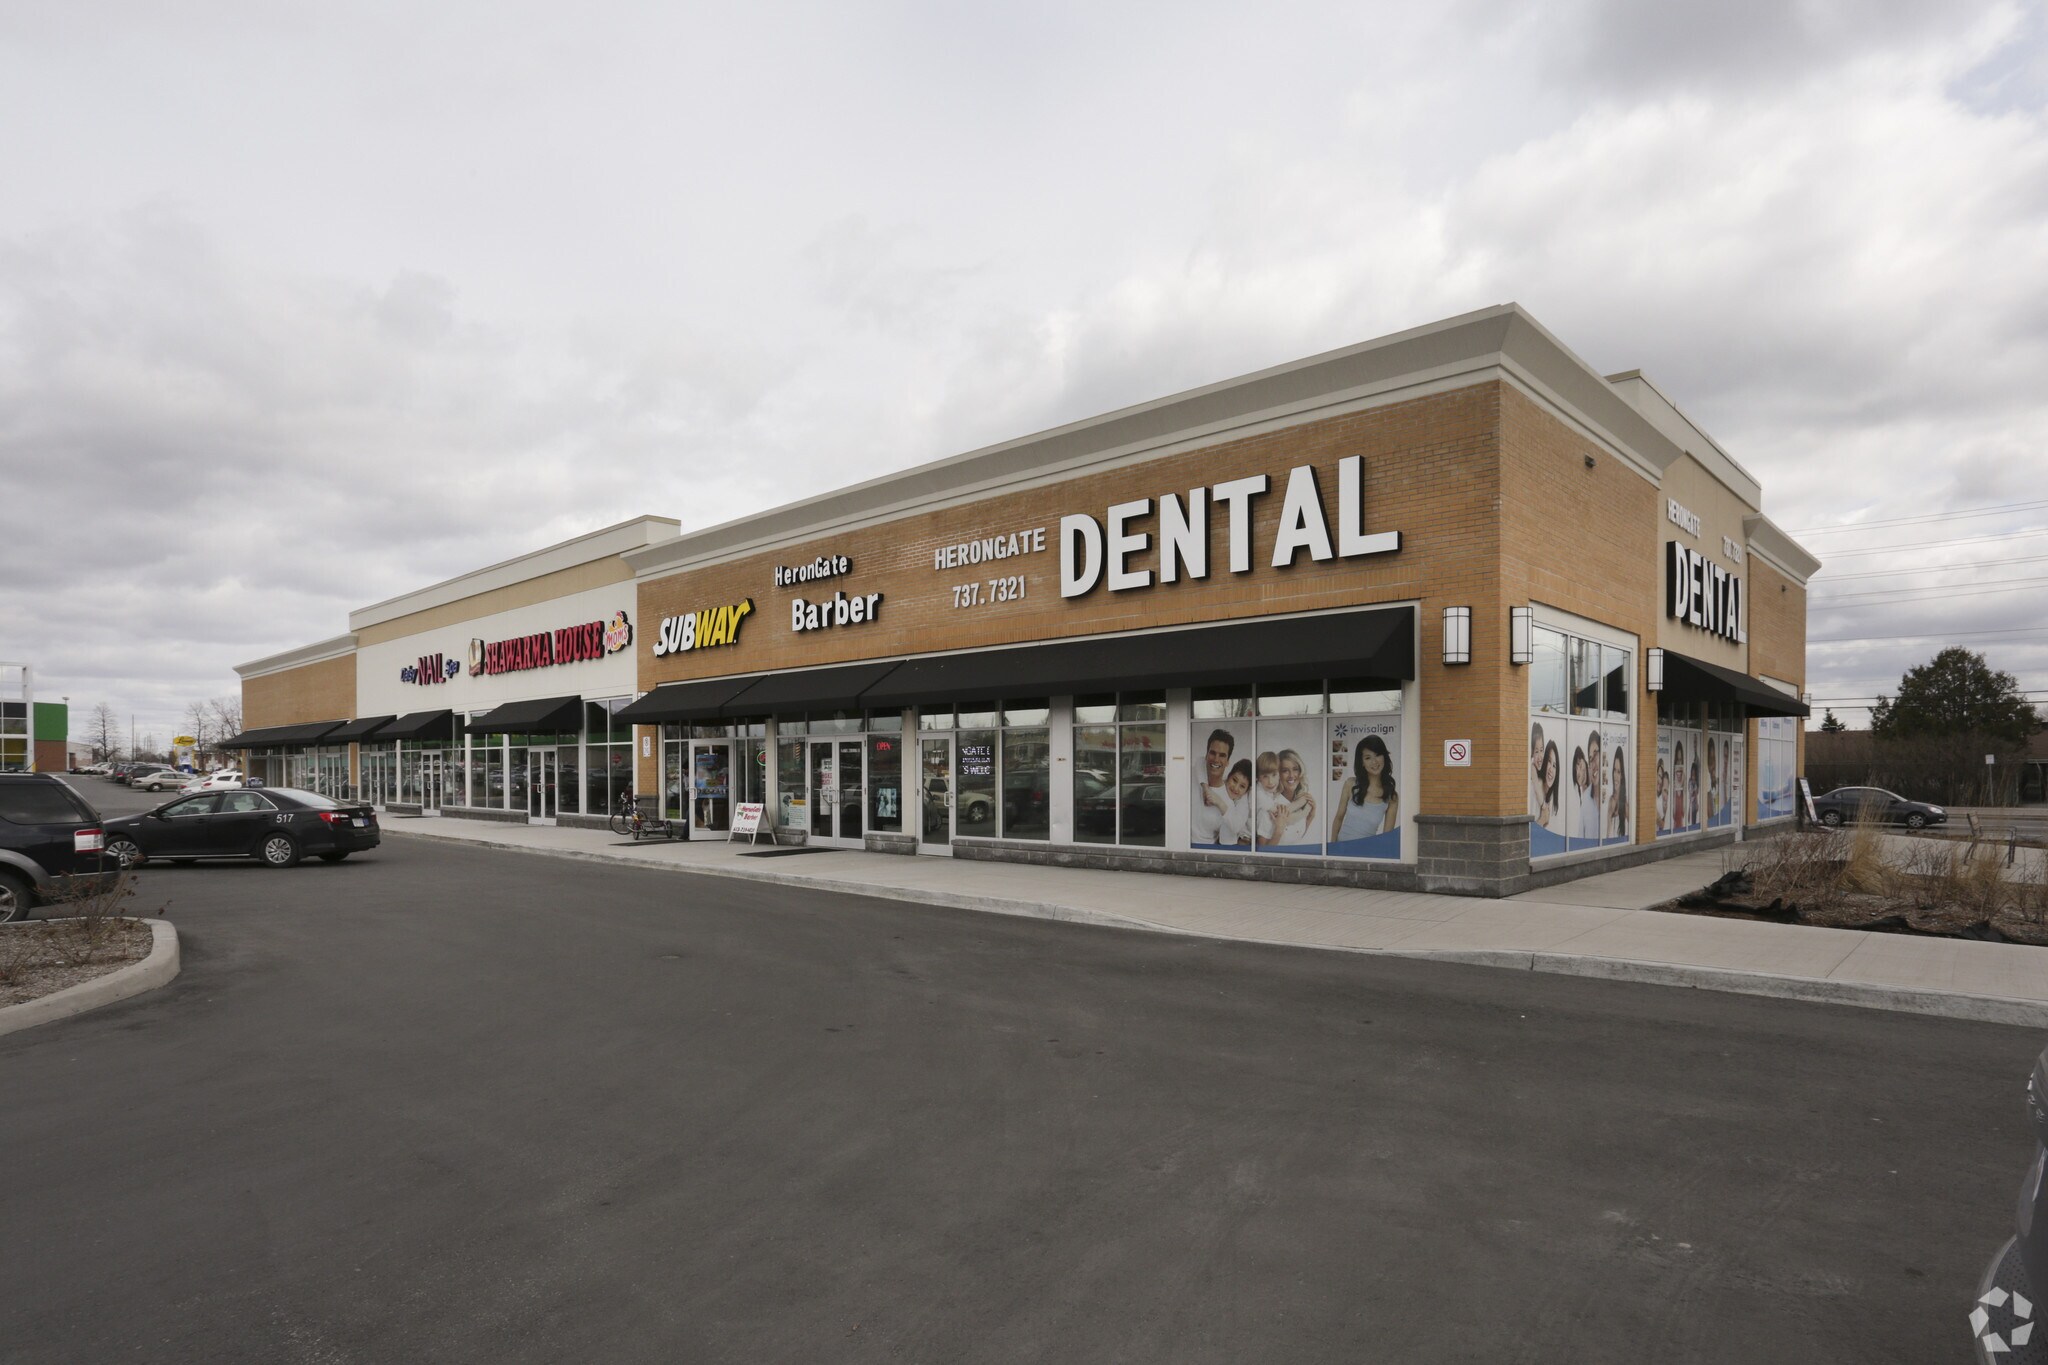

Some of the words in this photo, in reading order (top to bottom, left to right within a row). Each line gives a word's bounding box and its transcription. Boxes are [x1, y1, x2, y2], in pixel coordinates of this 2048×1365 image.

[1060, 454, 1401, 598] DENTAL
[934, 527, 1046, 571] HERONGATE
[775, 555, 850, 586] HeronGate
[952, 575, 1026, 608] 737.7321
[1671, 541, 1747, 644] DENTAL
[652, 598, 753, 657] SUBWAY
[791, 592, 880, 632] Barber
[485, 631, 552, 676] SHAWARMA
[554, 620, 604, 664] HOUSE
[418, 653, 446, 685] NAIL
[1350, 723, 1395, 735] invisalign
[276, 813, 295, 823] 517
